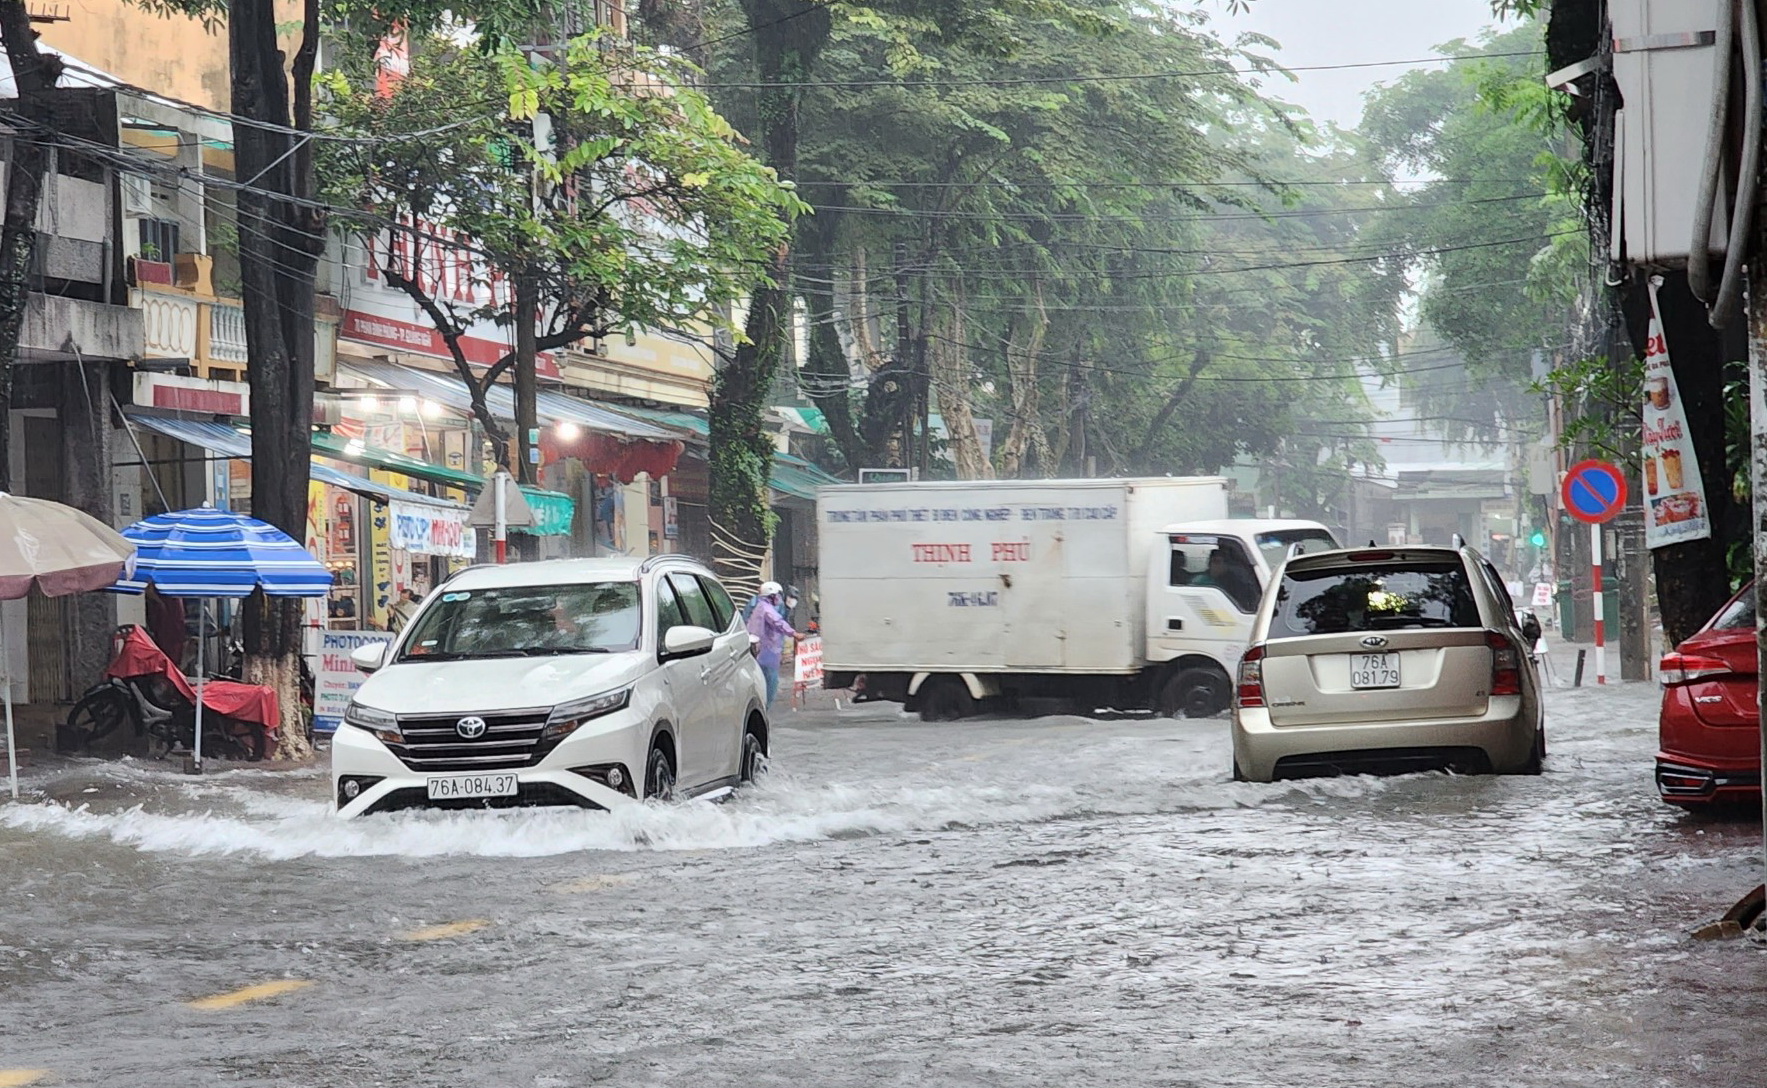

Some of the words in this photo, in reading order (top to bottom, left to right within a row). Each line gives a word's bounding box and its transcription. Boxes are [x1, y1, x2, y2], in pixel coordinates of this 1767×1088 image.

[1362, 654, 1388, 670] 76A
[1353, 670, 1398, 685] 081.79
[431, 776, 514, 796] 76A-084.37
